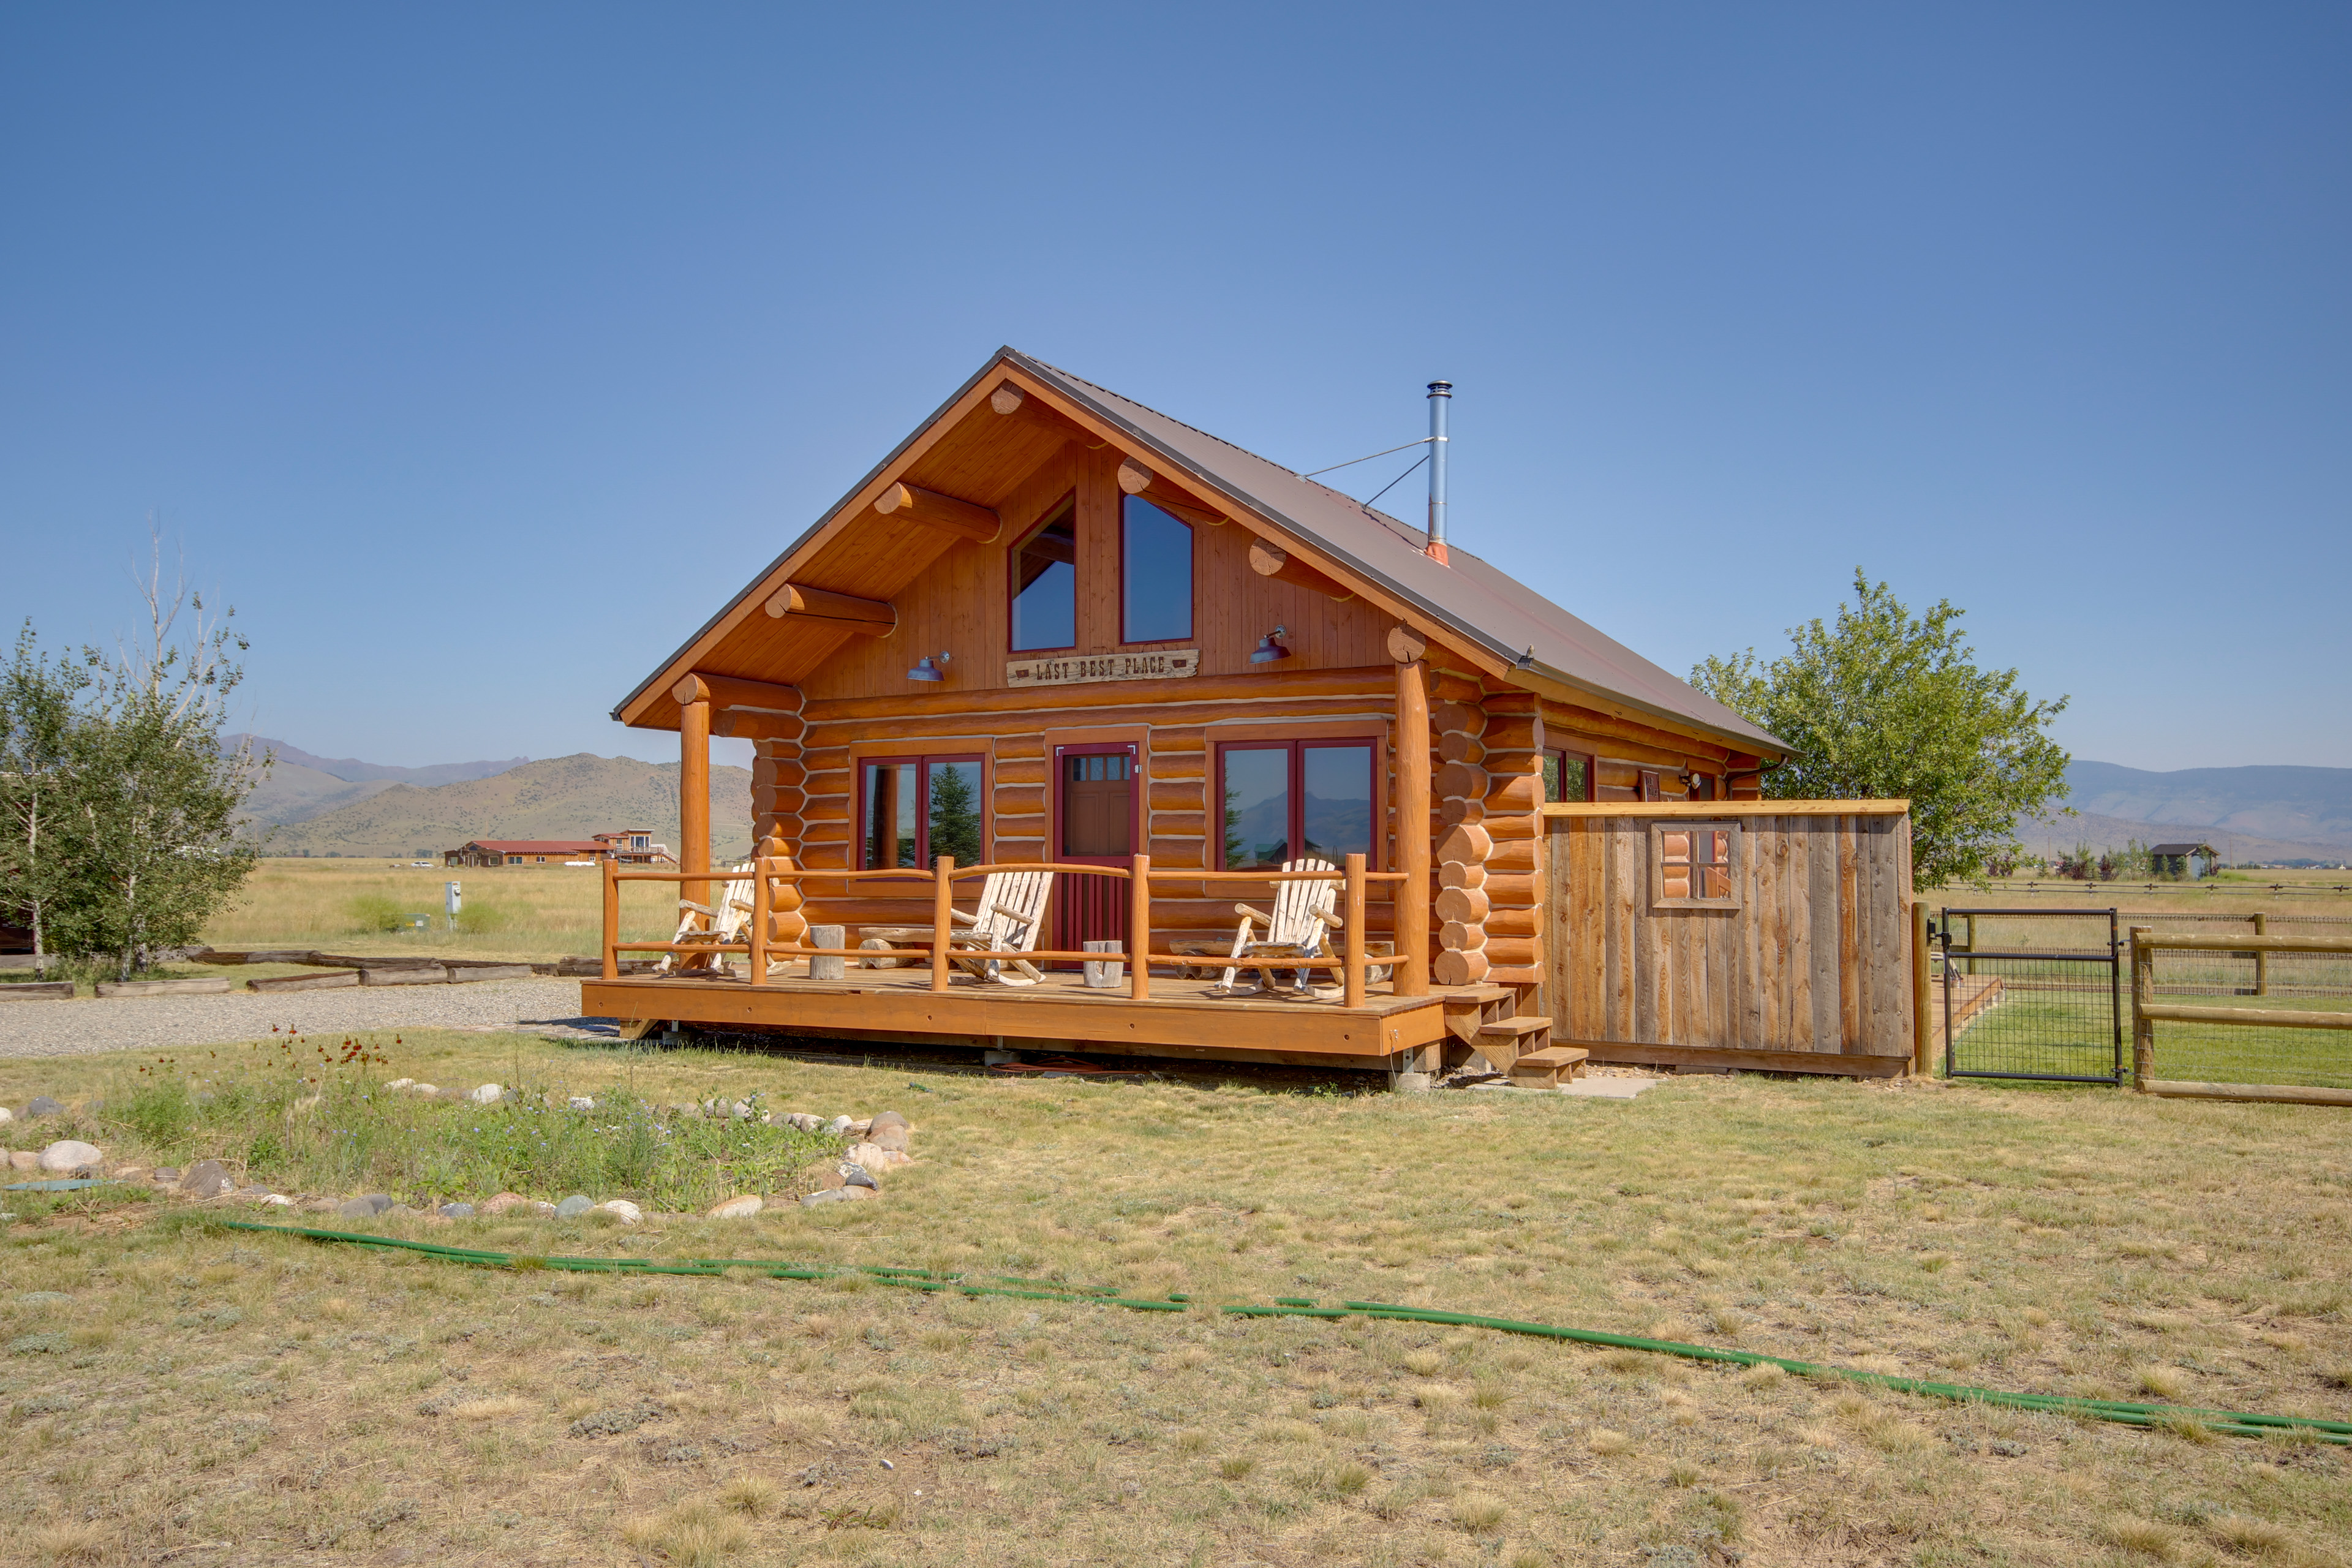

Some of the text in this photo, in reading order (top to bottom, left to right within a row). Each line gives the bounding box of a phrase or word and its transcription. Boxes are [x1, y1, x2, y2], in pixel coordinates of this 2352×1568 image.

[1036, 657, 1164, 680] LAST BEST PLACE
